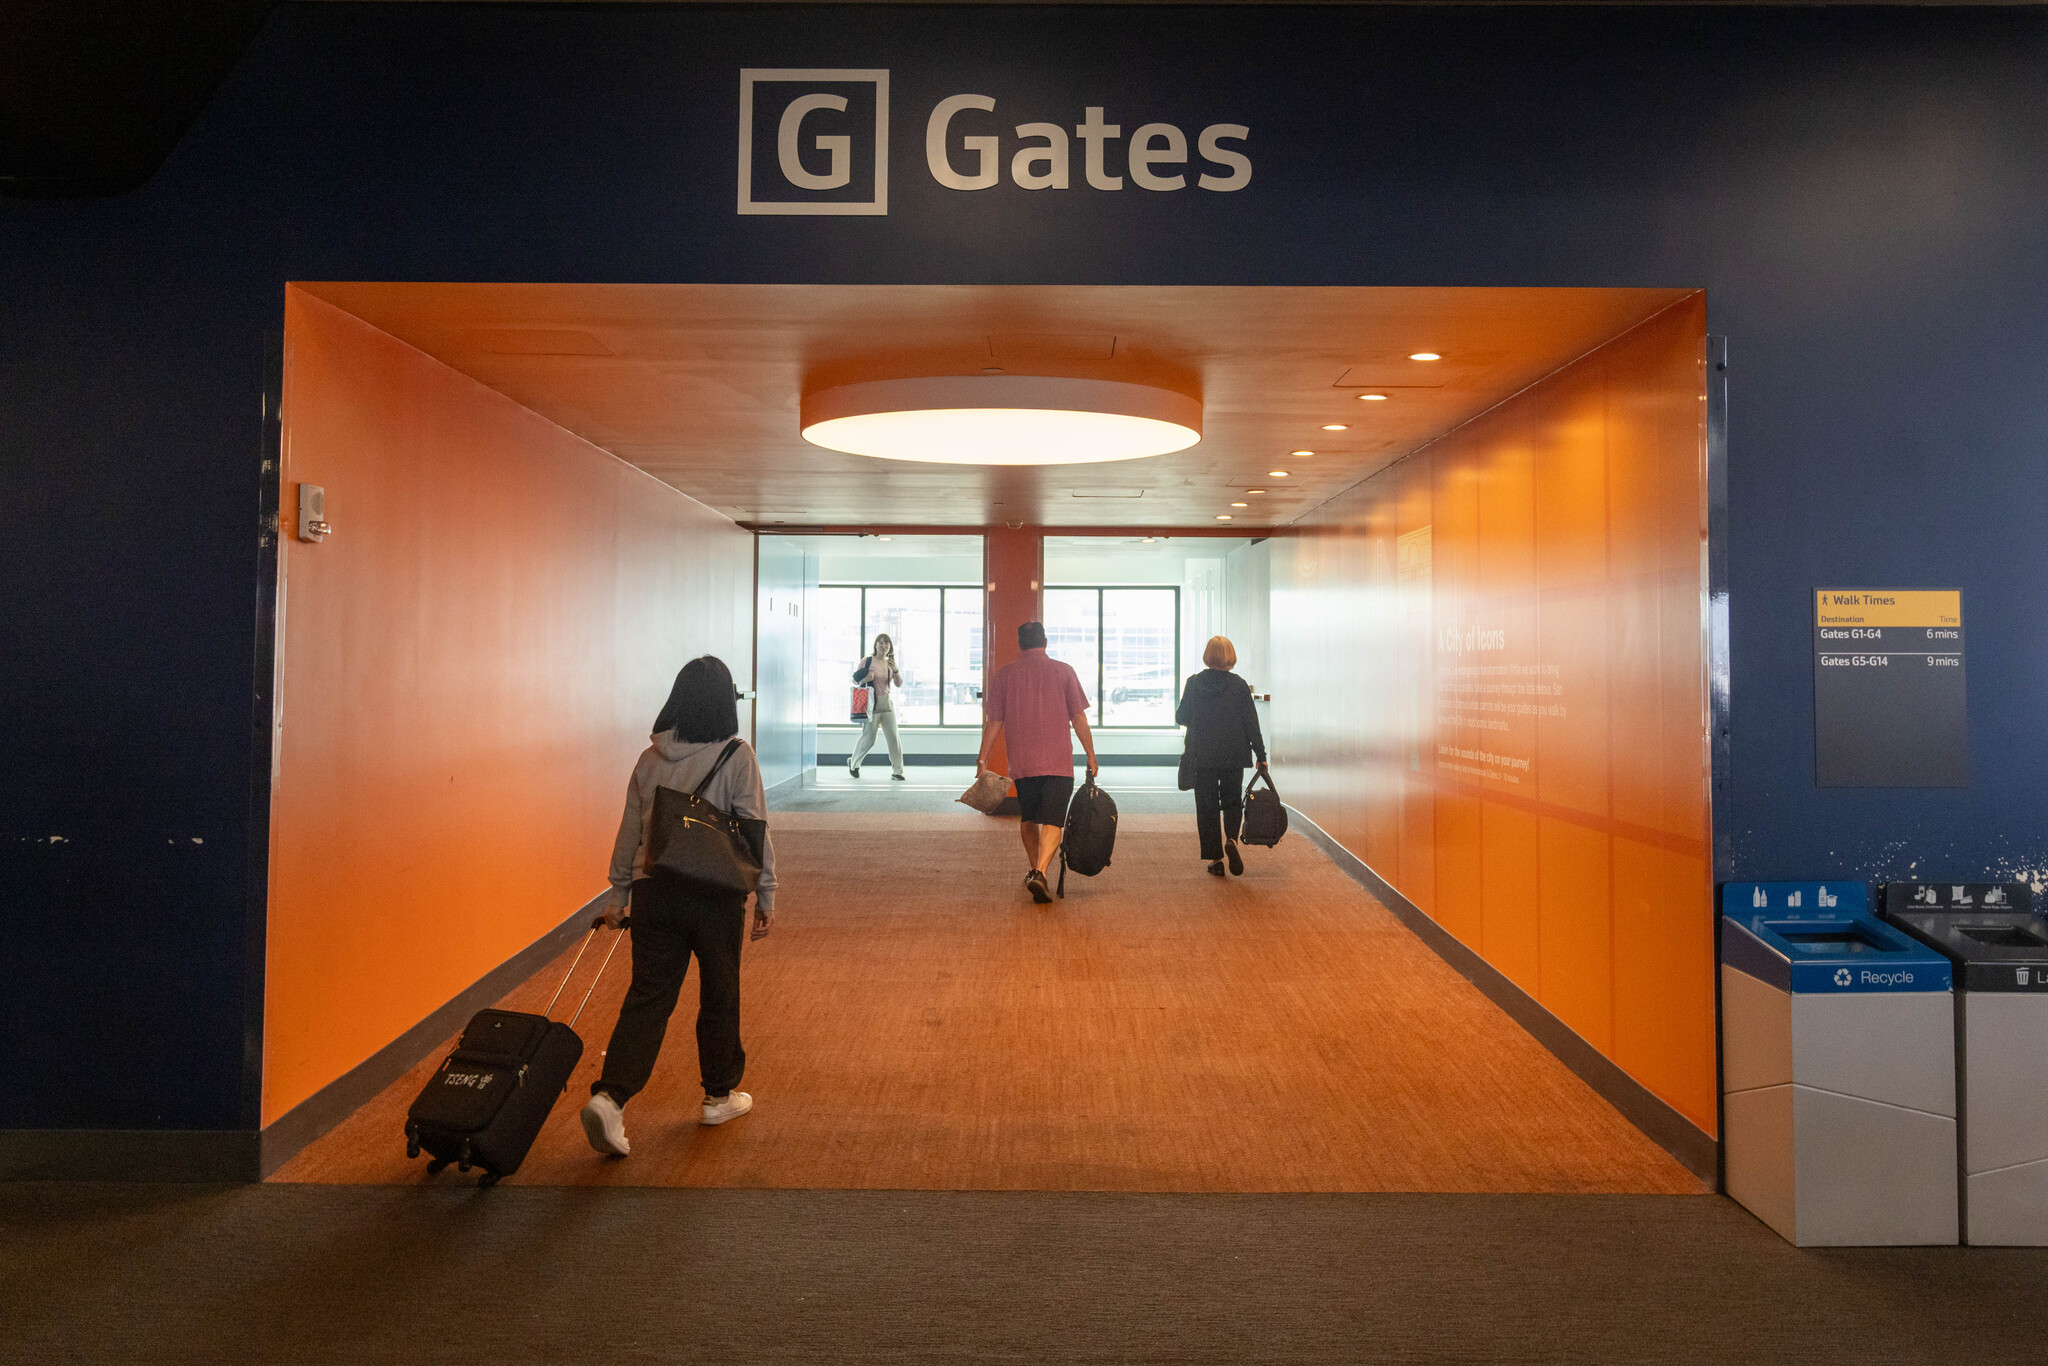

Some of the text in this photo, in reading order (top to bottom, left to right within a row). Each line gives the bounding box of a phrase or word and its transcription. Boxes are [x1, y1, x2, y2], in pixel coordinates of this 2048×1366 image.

[777, 93, 1253, 192] G Gates
[1833, 595, 1895, 605] Walk Times
[1820, 615, 1864, 623] Destination
[1820, 629, 1882, 639] Gates G1-G4
[1926, 629, 1959, 639] 6 mins
[1438, 625, 1504, 656] A City of Icons
[1821, 656, 1888, 666] Gates G5-G14
[1927, 656, 1959, 666] 9 mins
[1861, 970, 1914, 985] Recycle
[2037, 970, 2048, 984] L
[444, 1073, 479, 1088] TSENG
